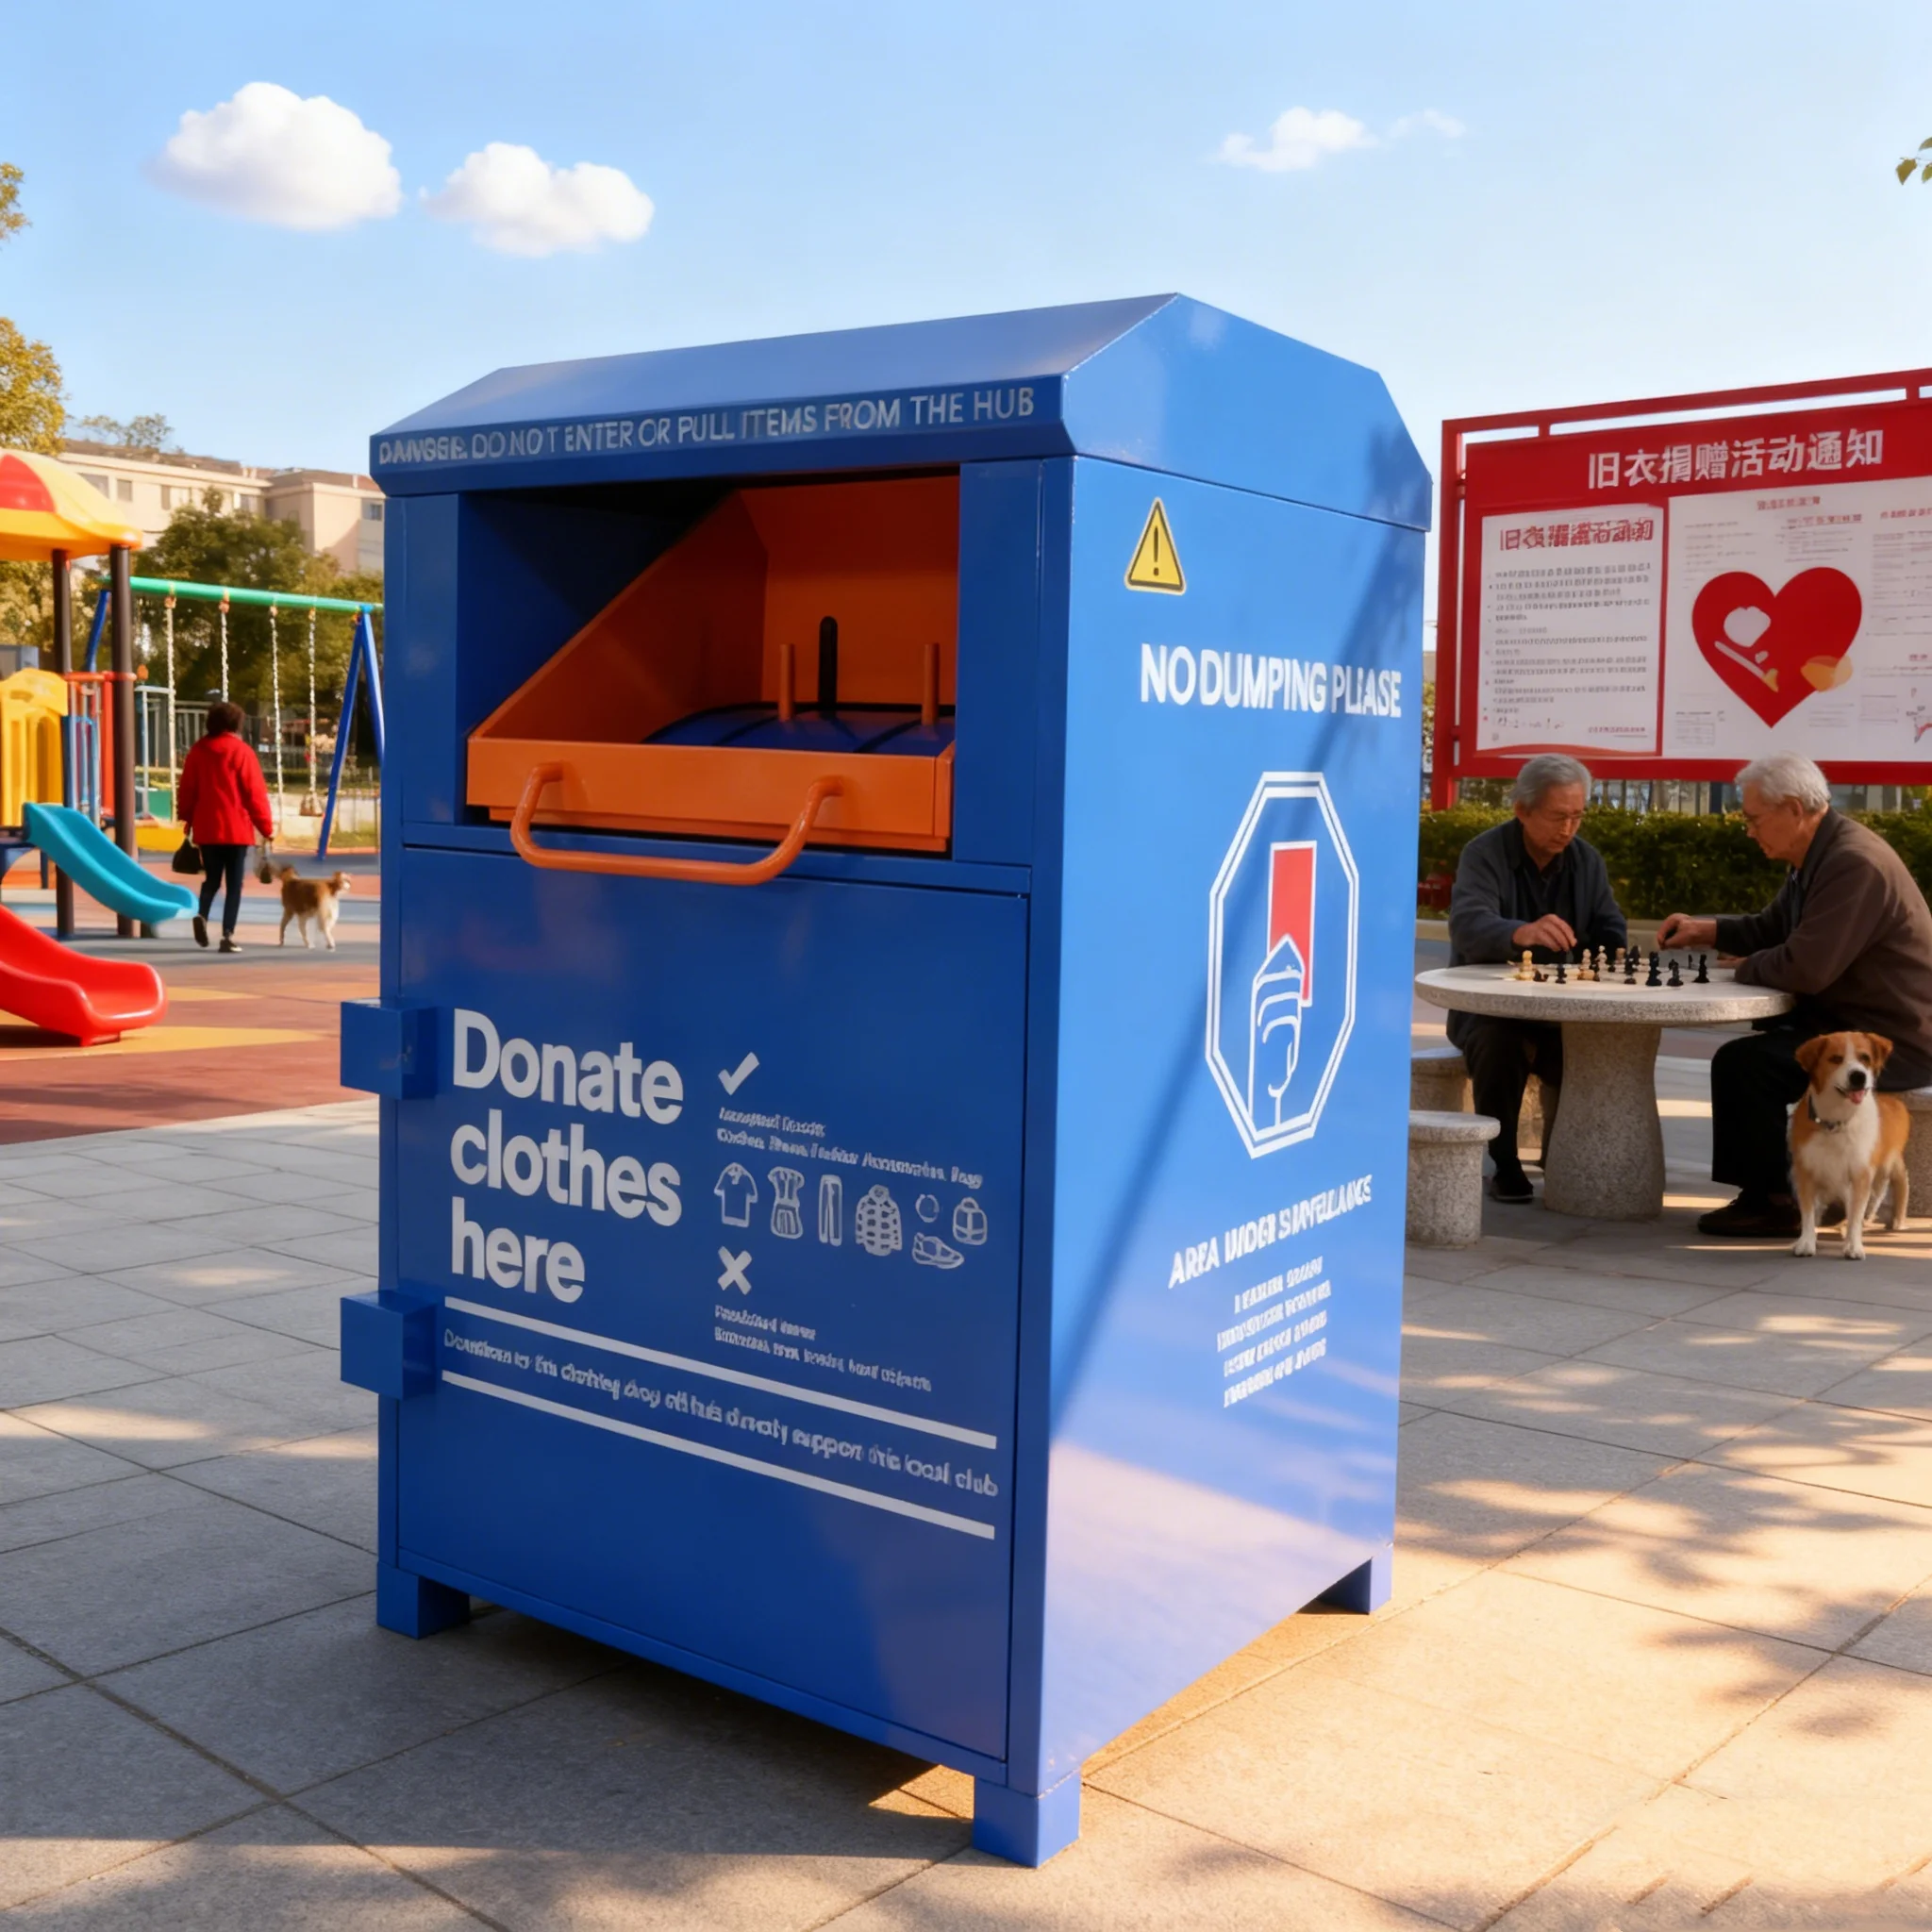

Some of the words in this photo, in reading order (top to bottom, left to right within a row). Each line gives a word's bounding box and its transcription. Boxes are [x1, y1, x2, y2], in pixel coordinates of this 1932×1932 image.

[472, 431, 507, 459] DO
[508, 426, 558, 457] NOT
[565, 421, 634, 453] ENTER
[638, 417, 671, 447] OR
[678, 411, 735, 443] PULL
[741, 406, 818, 440] ITEMS
[824, 398, 901, 432] FROM
[909, 392, 964, 425] THE
[973, 387, 1035, 421] HUB
[1141, 642, 1196, 706] NO
[1199, 648, 1327, 713] DUMPING
[453, 1008, 684, 1124] Donate
[450, 1108, 683, 1226] clothes
[452, 1195, 586, 1304] here
[955, 1468, 999, 1497] club
